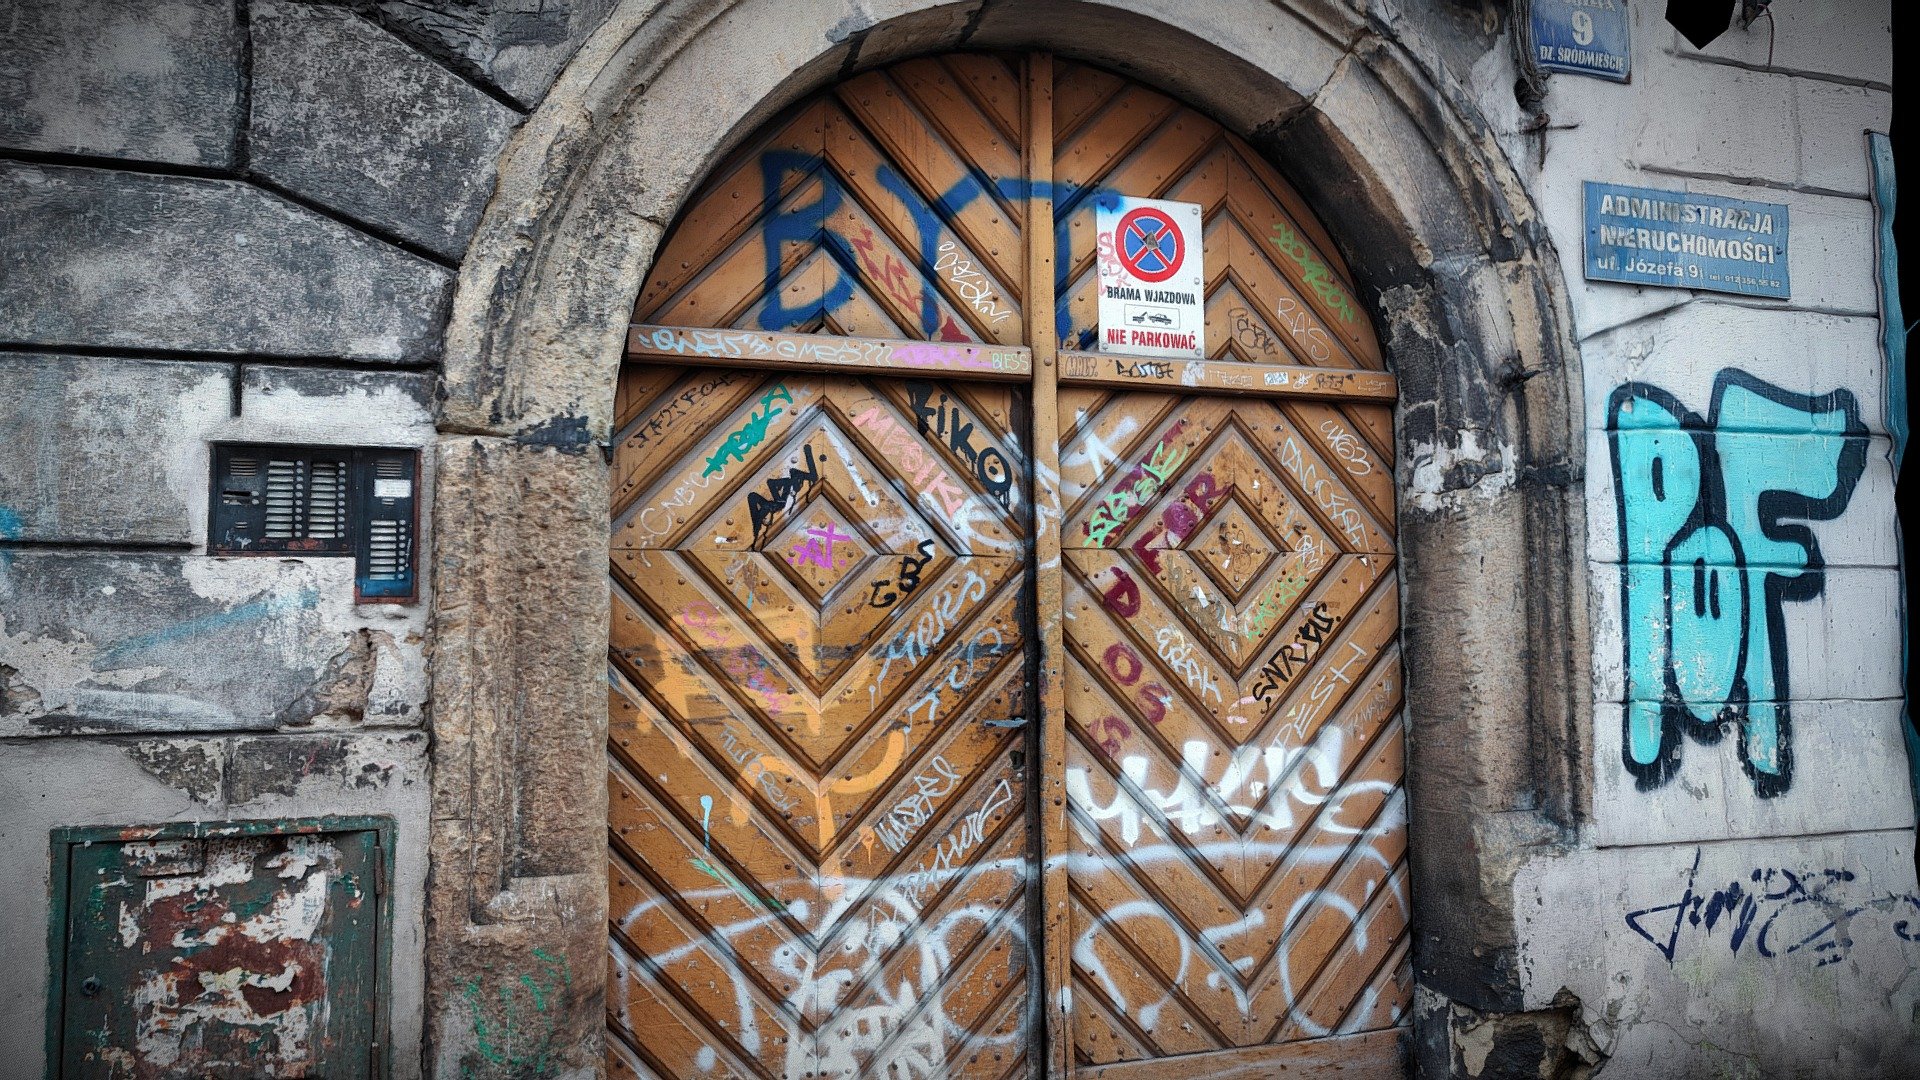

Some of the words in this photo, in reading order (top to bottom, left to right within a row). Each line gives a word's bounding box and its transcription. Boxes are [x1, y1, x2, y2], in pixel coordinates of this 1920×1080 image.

[1570, 10, 1594, 46] 9
[1557, 44, 1625, 71] ŚRÓDMIEŚCIE
[1600, 193, 1774, 235] ADMINISTRACJA
[1600, 225, 1776, 264] NIERUCHOMOŚCI
[1597, 256, 1620, 271] ul.
[1625, 259, 1684, 277] Józefa
[1107, 286, 1141, 301] BRAMA
[1144, 289, 1196, 305] WJAZDOWA
[1107, 328, 1126, 345] NIE
[1131, 329, 1197, 350] PARKOWAĆ
